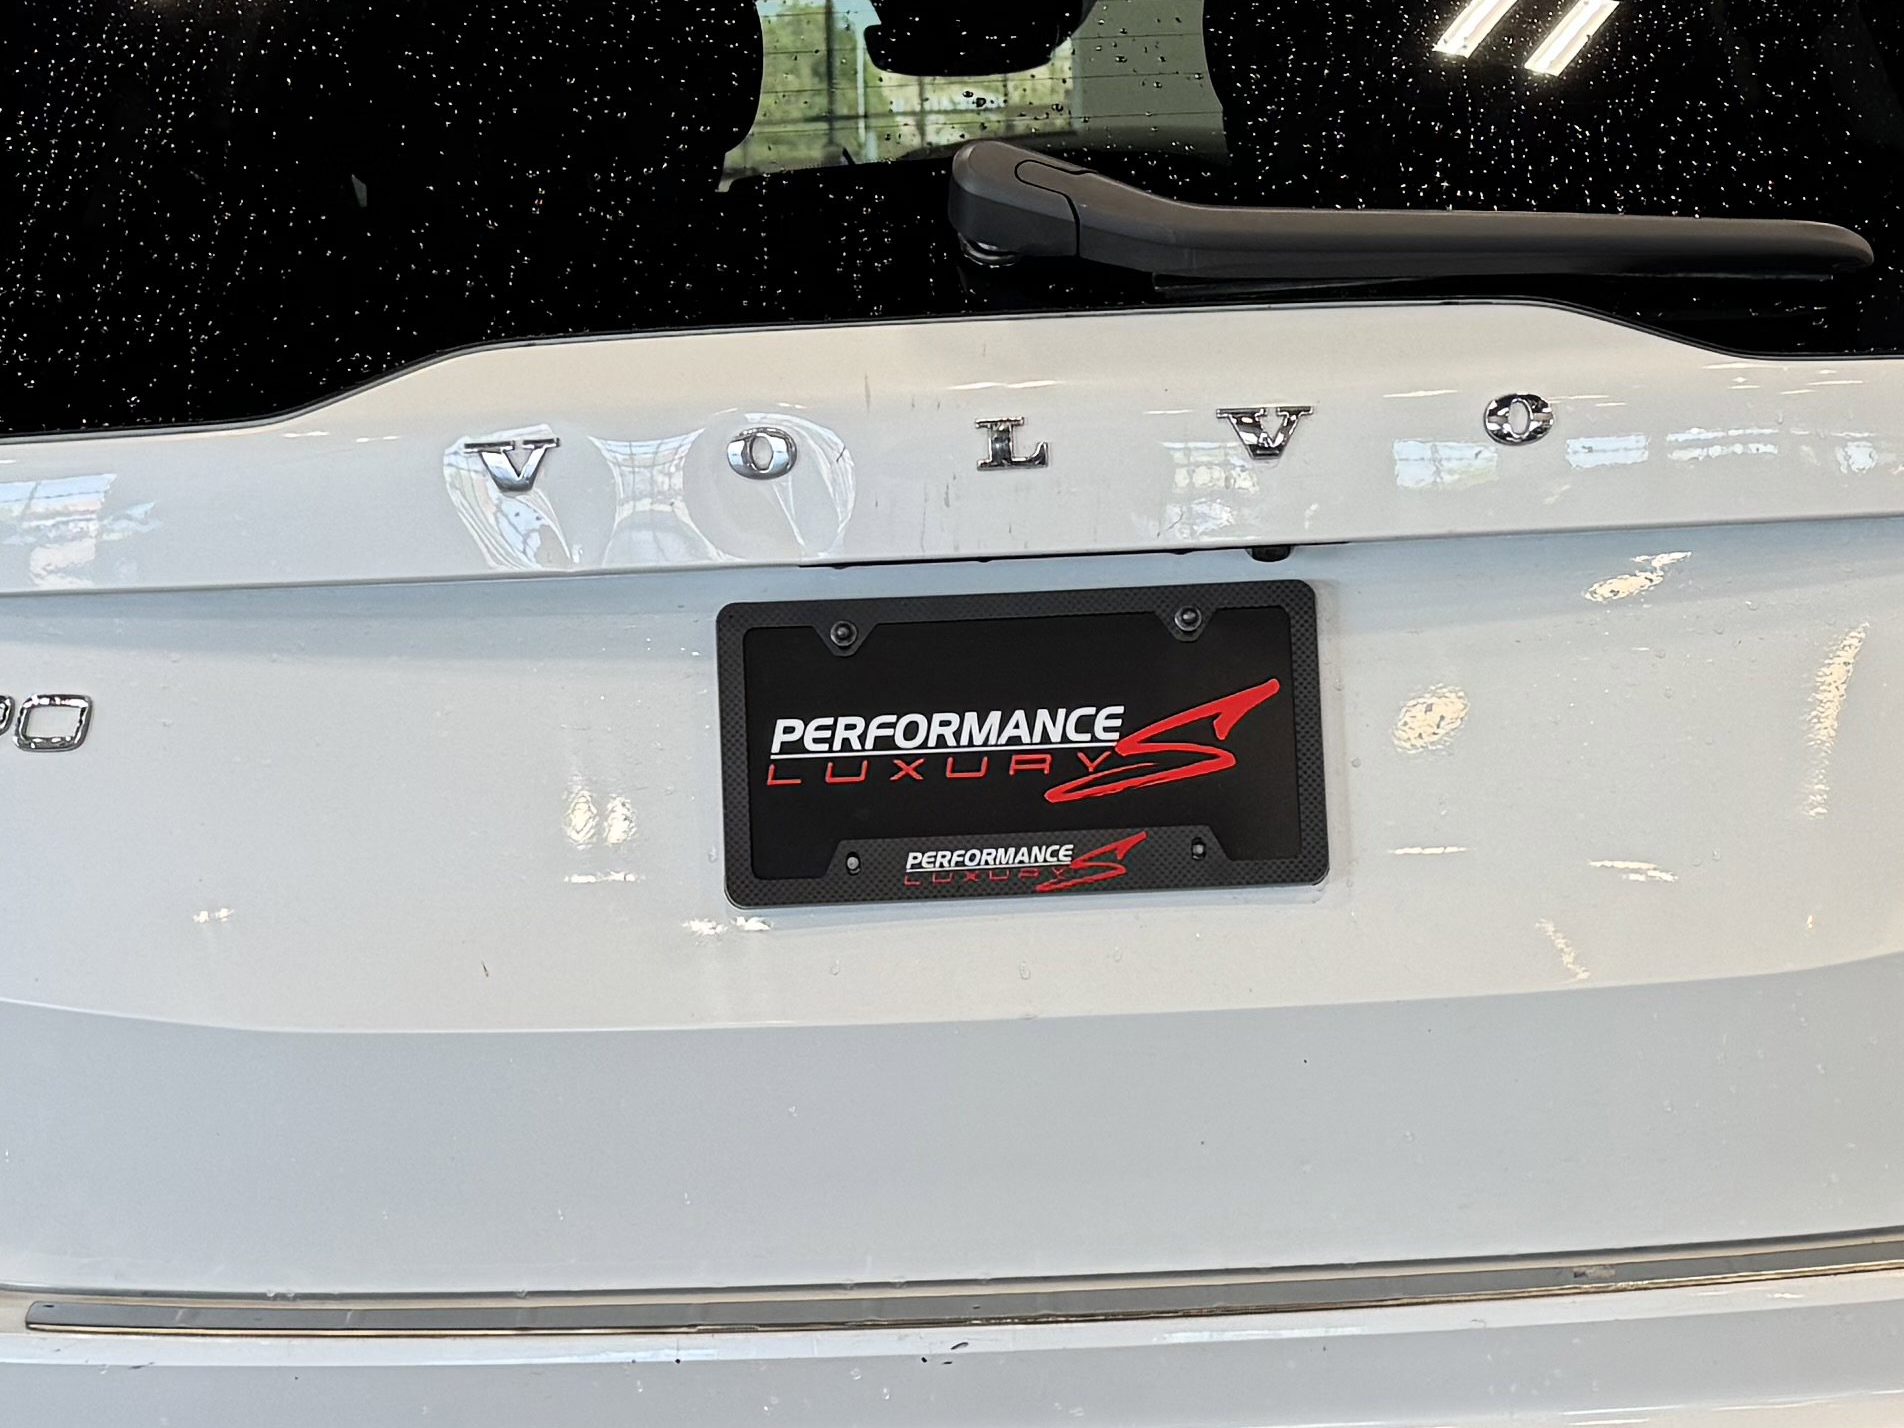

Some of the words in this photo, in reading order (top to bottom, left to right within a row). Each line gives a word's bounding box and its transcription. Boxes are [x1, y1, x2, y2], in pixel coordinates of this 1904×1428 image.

[464, 392, 1556, 493] VOLVO
[770, 705, 1126, 755] PERFORMANCE
[766, 751, 1112, 786] LUXURY
[905, 844, 1075, 869] PERFORMANCE
[903, 865, 1068, 886] LUXURY
